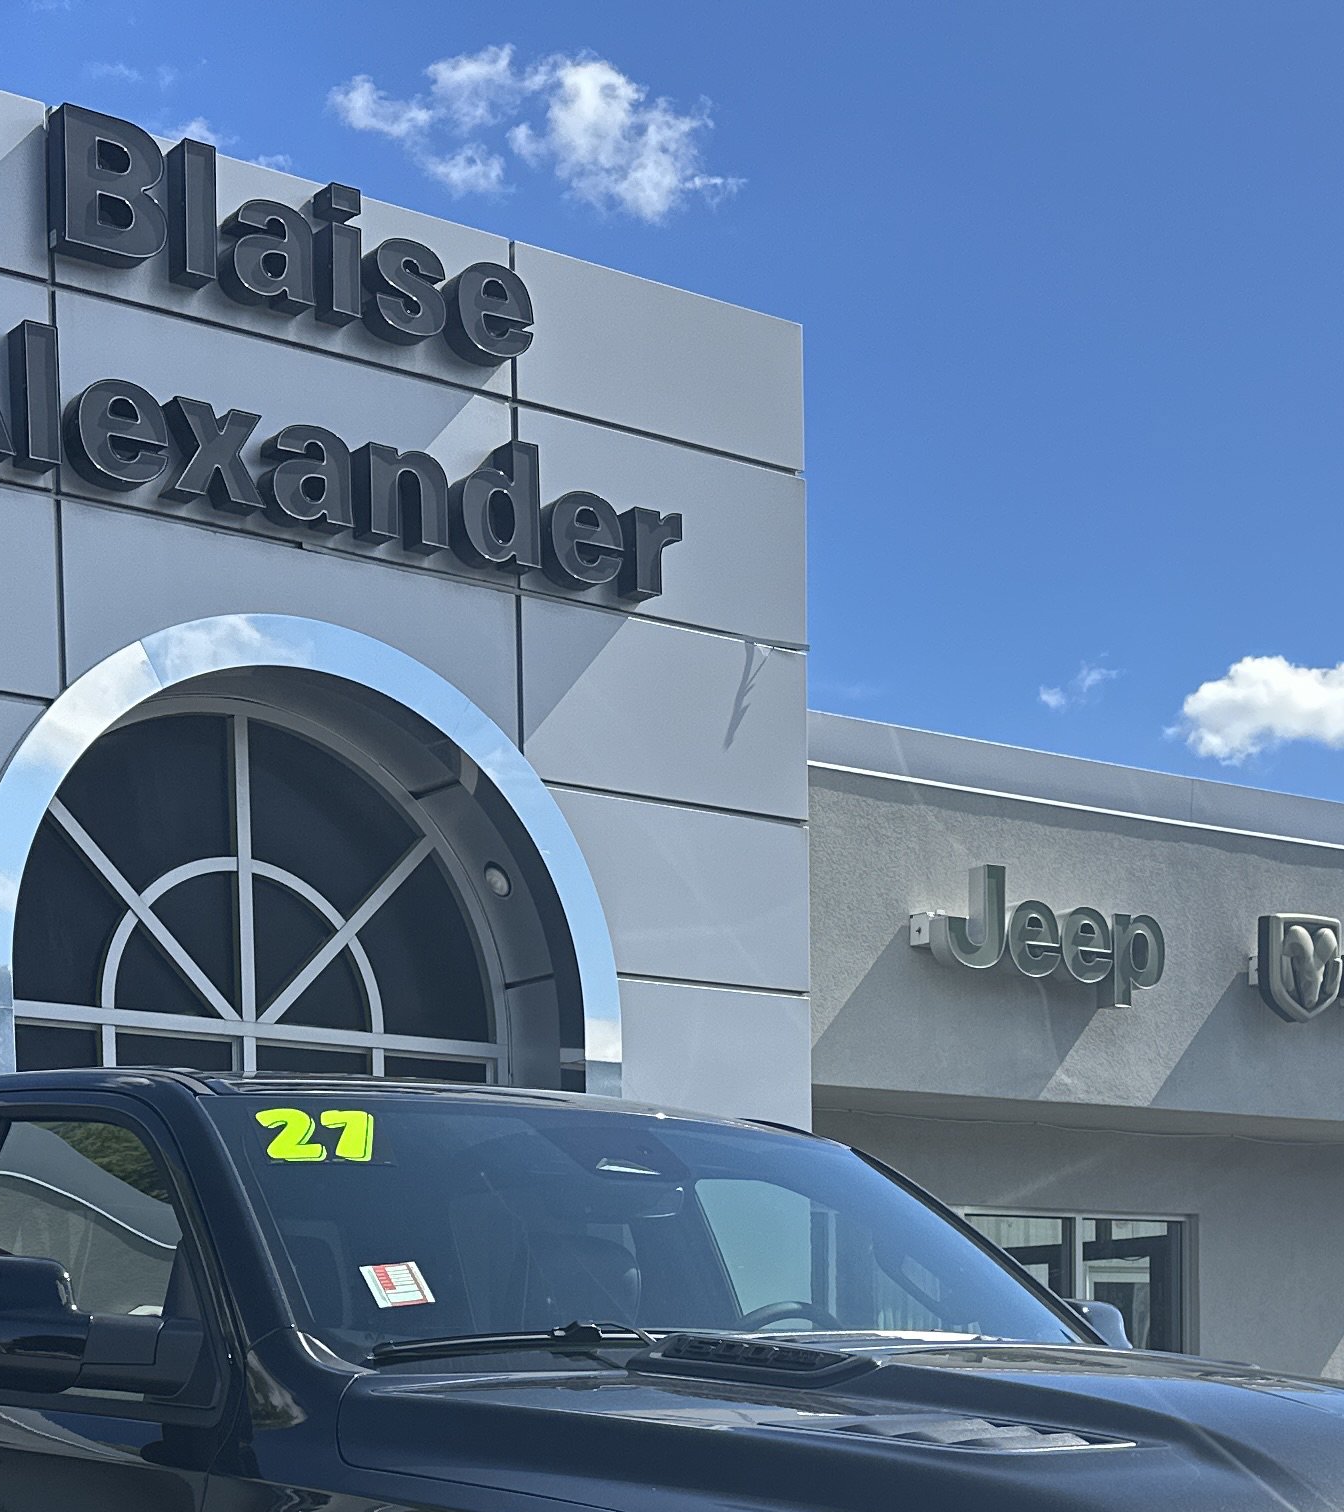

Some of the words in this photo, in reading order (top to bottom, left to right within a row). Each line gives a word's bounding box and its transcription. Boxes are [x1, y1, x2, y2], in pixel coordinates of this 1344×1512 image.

[48, 102, 534, 366] Blaise
[929, 863, 1165, 1008] Jeep
[255, 1108, 374, 1162] 27
